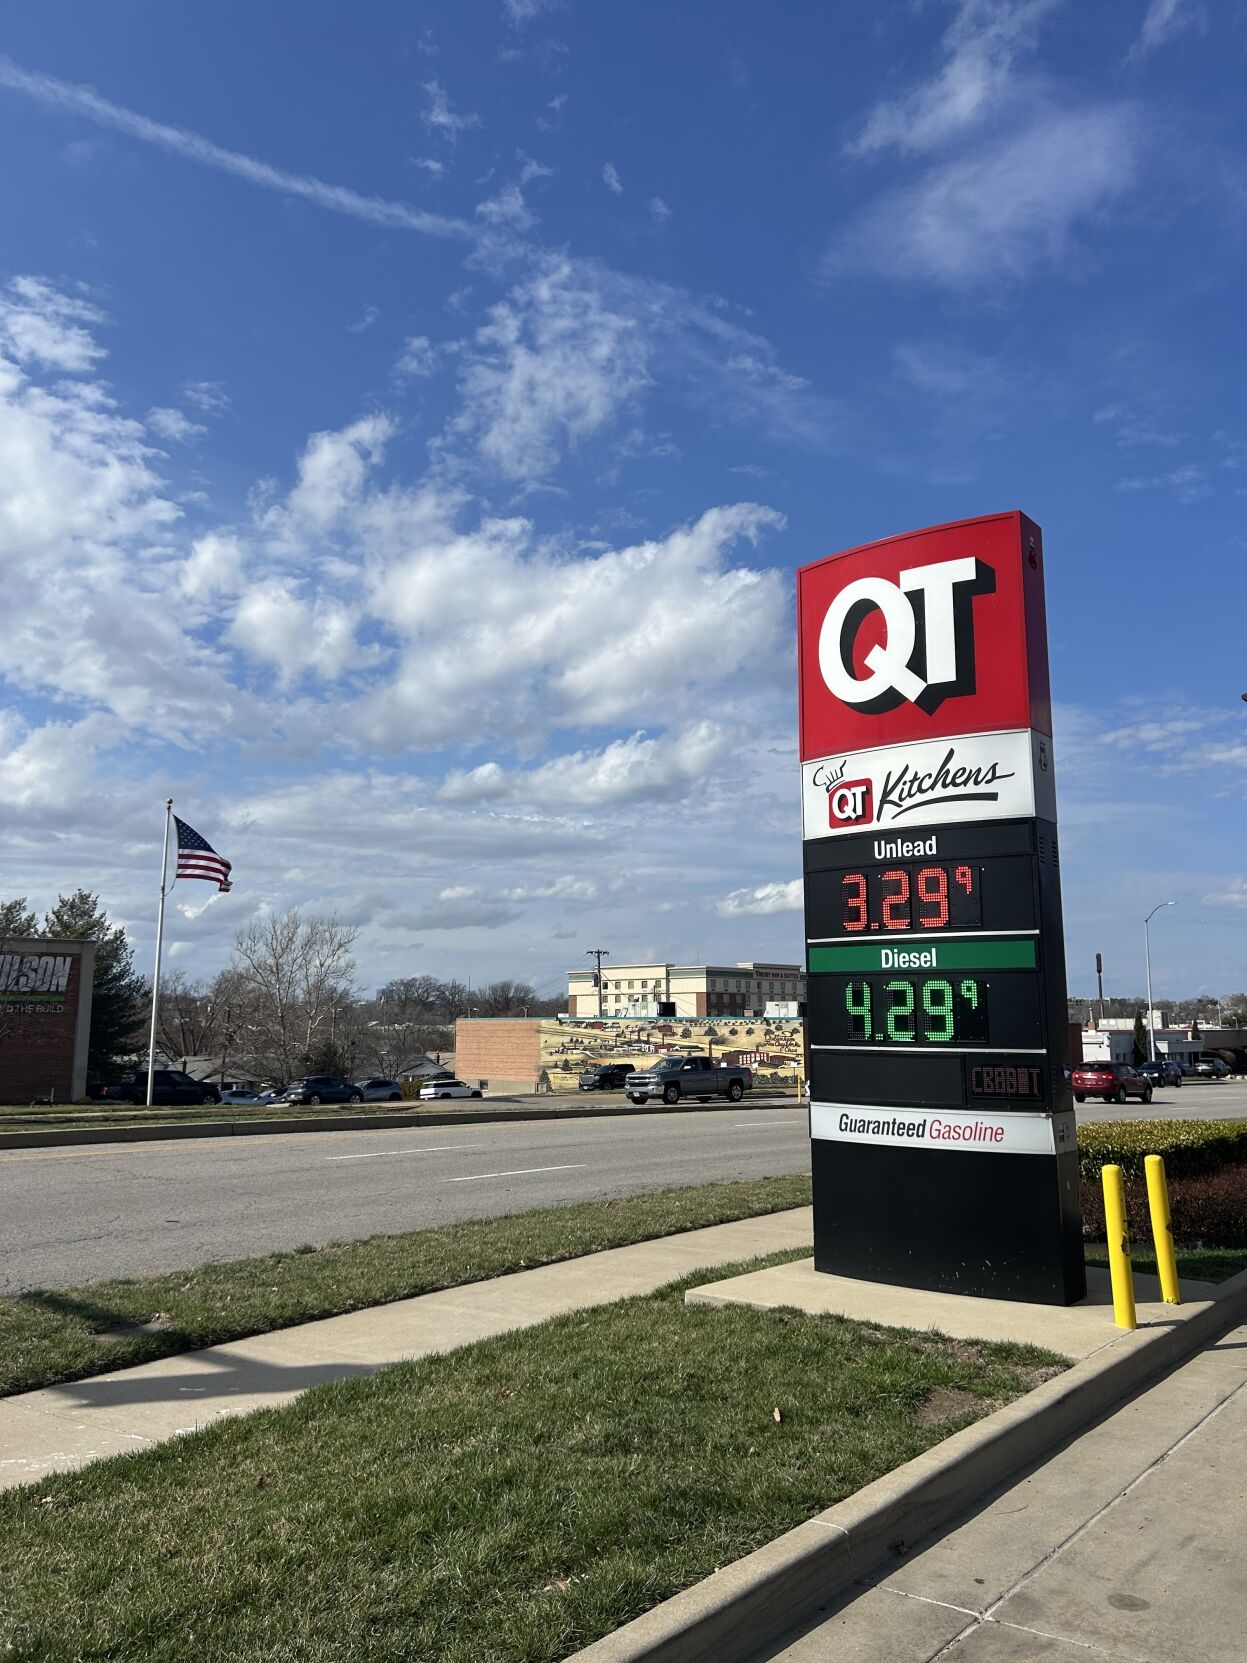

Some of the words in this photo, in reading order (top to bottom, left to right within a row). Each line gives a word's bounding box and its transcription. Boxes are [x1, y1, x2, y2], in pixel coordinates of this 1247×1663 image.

[818, 556, 977, 703] QT
[831, 785, 869, 820] QT
[876, 748, 1015, 822] Kitchens
[873, 836, 937, 859] Unlead
[881, 948, 937, 969] Diesel
[838, 1113, 927, 1138] Guaranteed
[929, 1119, 1004, 1143] Gasoline
